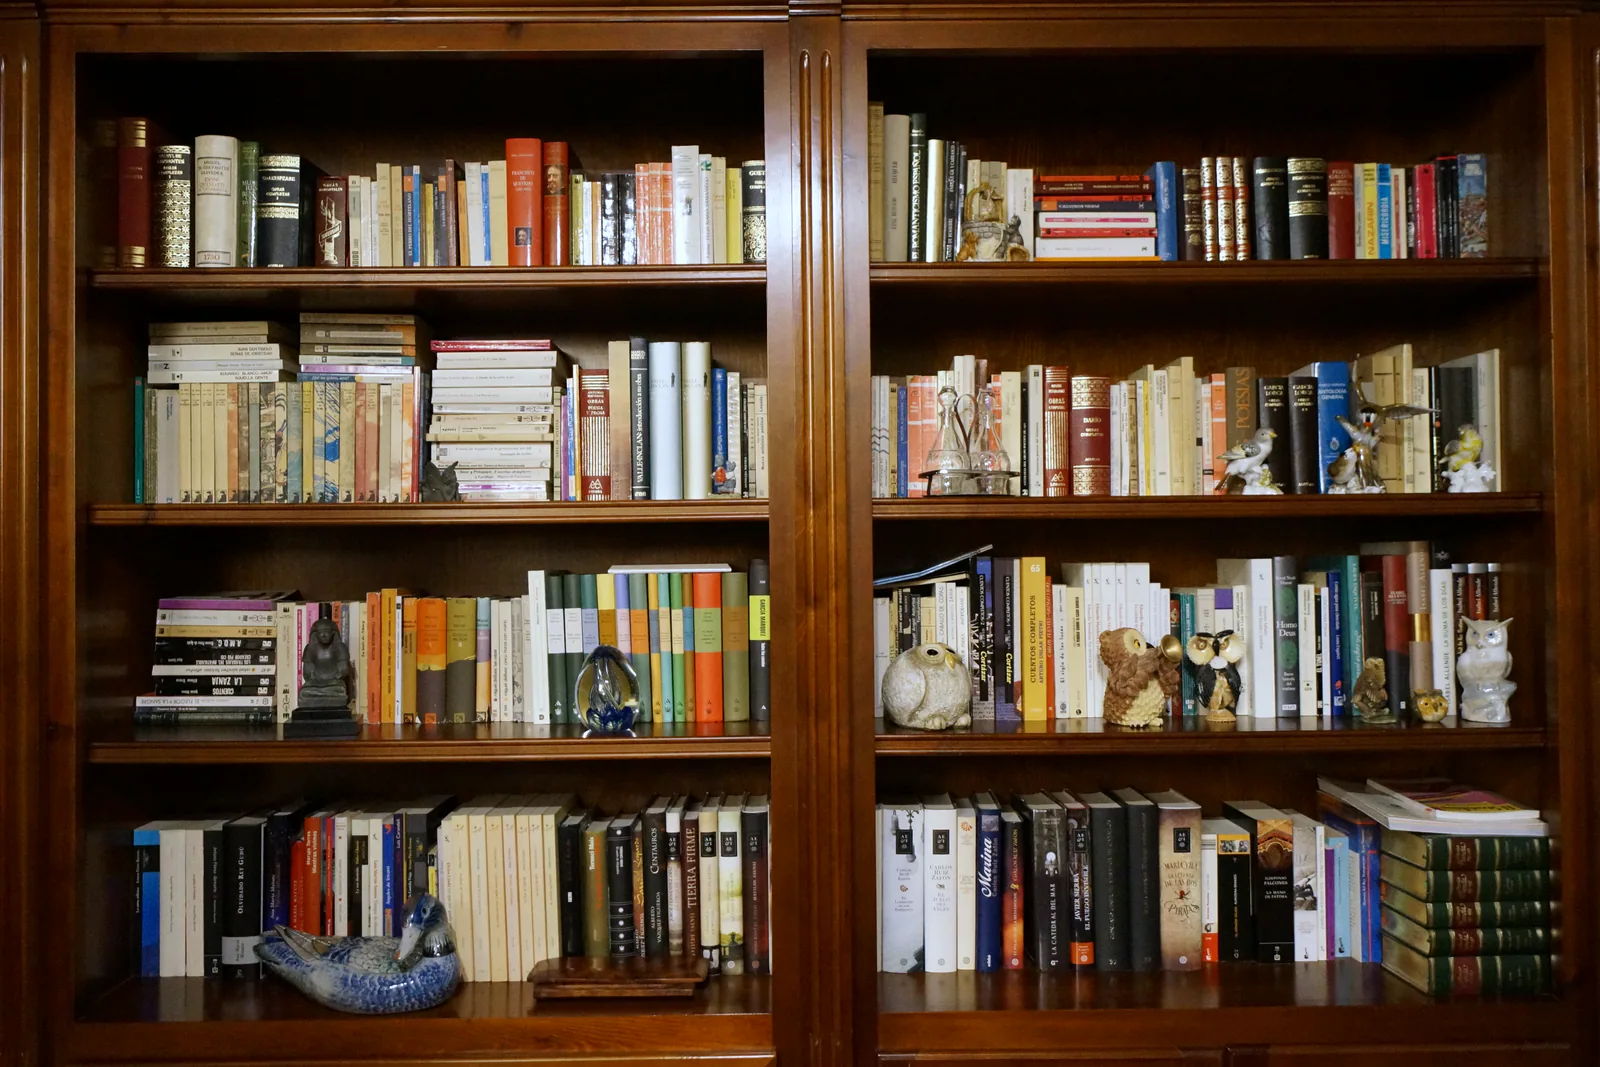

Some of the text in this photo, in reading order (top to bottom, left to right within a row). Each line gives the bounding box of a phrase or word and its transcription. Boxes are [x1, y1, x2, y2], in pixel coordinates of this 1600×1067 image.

[1236, 368, 1250, 428] POESIAS
[1030, 564, 1041, 572] 65
[1276, 620, 1298, 628] Homo
[650, 827, 660, 874] CENTAUROS
[686, 828, 697, 908] TIERRA FIRME
[978, 837, 992, 898] Marina
[1074, 898, 1082, 921] JAVIER
[1084, 922, 1090, 930] EL
